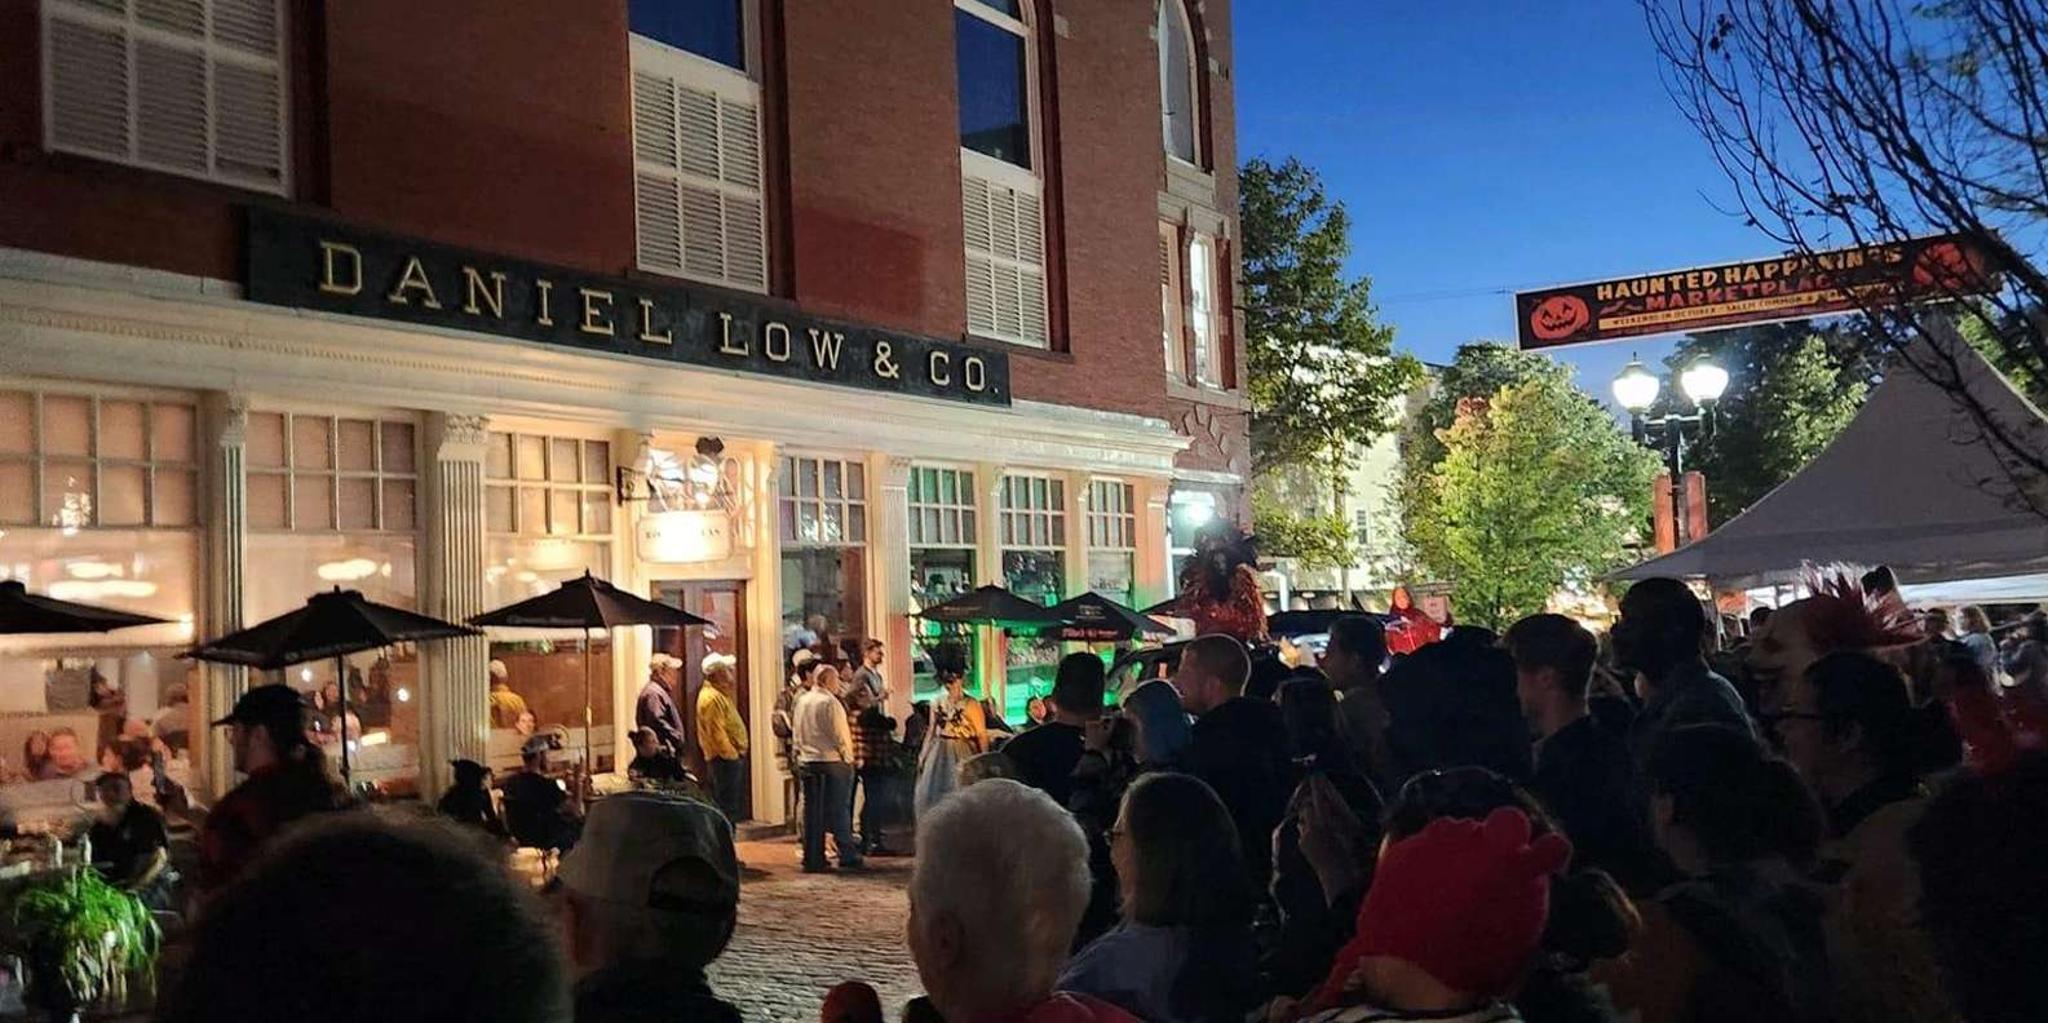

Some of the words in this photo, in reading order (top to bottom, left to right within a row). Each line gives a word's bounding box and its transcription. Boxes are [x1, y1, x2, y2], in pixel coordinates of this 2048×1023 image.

[1597, 270, 1718, 300] HAUNTED
[1724, 247, 1902, 284] HAPPNINS
[1646, 273, 1842, 311] MARKETPLAC
[320, 242, 673, 345] DANIEL
[719, 312, 848, 370] LOW
[874, 341, 899, 380] &
[930, 351, 1000, 394] CO.
